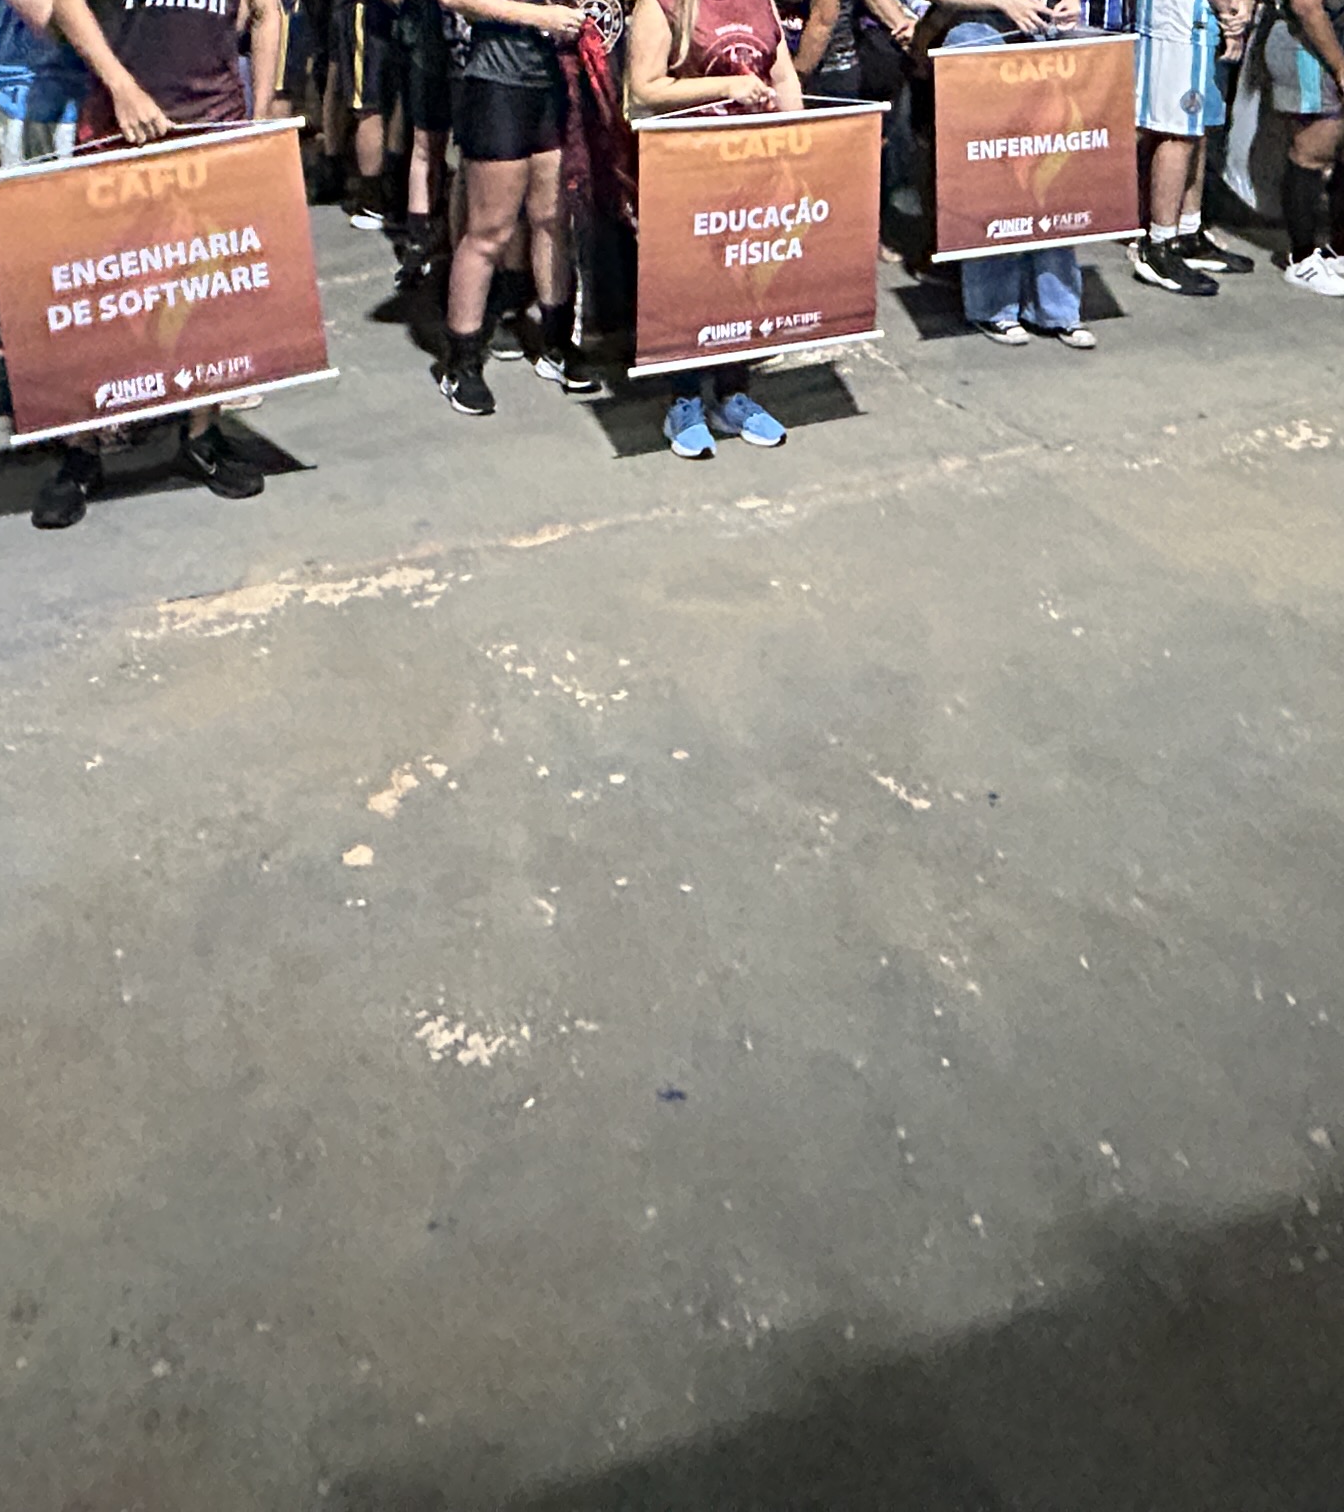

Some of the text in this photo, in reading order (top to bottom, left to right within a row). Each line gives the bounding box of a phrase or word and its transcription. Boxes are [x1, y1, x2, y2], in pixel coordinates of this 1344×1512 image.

[999, 54, 1077, 84] CAFU
[719, 126, 813, 162] CAFU
[966, 128, 1109, 161] ENFERMAGEM
[86, 157, 209, 208] CAFU
[693, 196, 829, 236] EDUCAÇÃO
[51, 225, 262, 292] ENGENHARIA
[724, 237, 803, 268] FÍSICA
[47, 262, 271, 333] DE SOFTWARE
